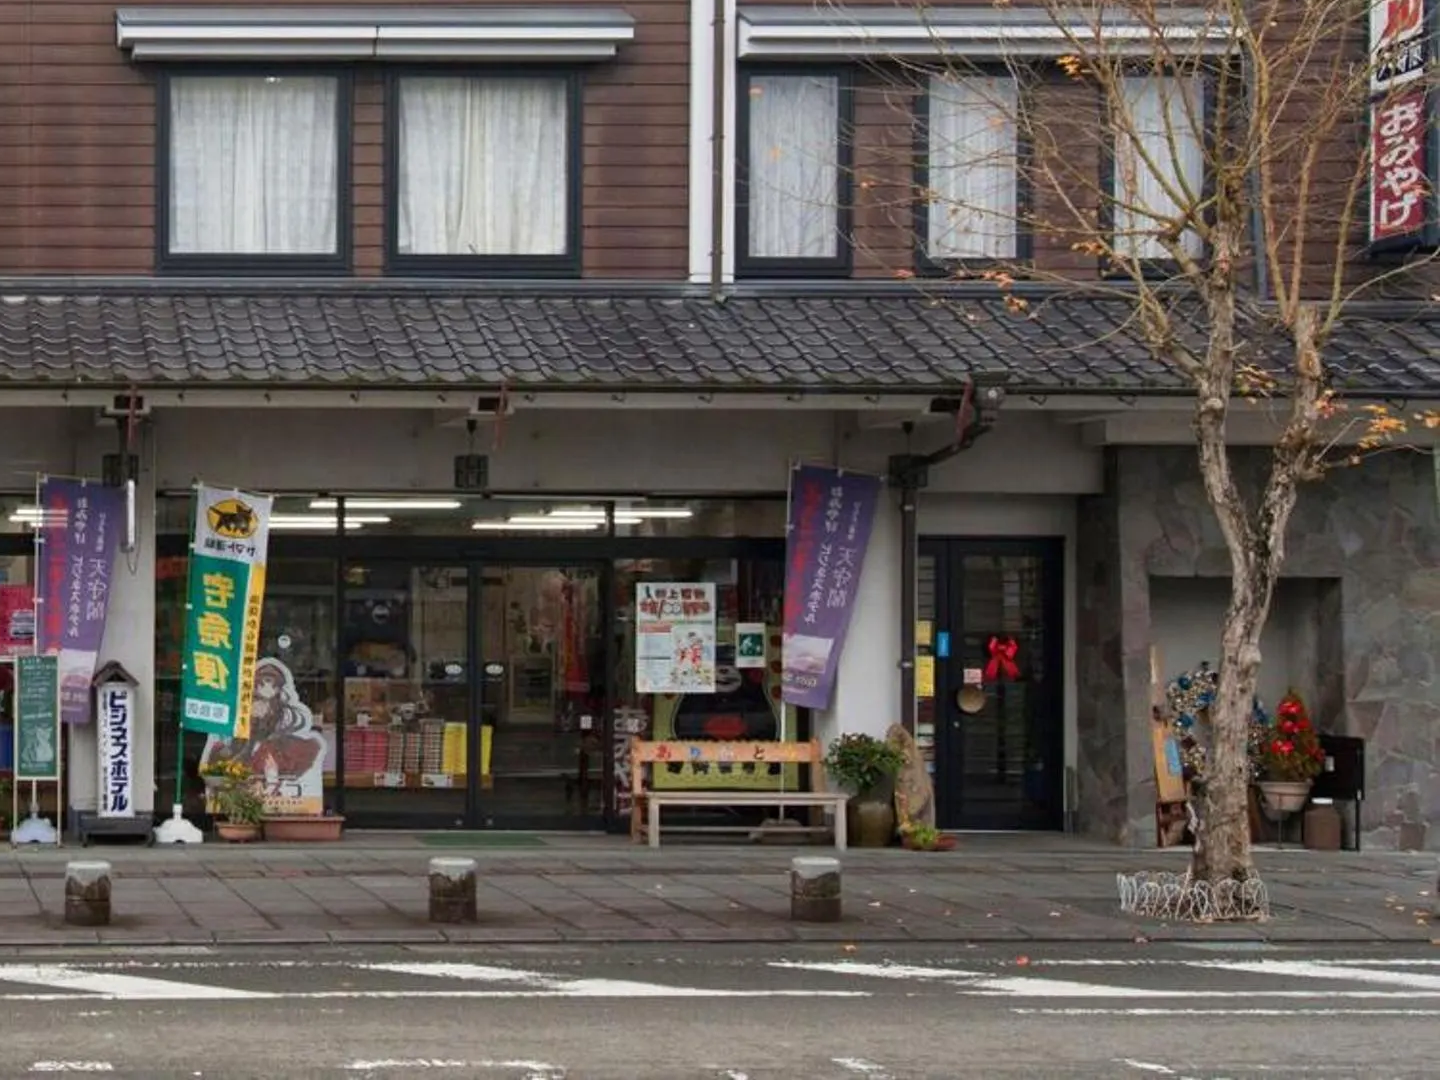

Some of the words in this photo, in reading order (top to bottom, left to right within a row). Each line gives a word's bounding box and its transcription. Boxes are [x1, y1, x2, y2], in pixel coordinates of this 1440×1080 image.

[1379, 101, 1421, 228] おみやげ
[110, 691, 128, 812] ビジネスホテル
